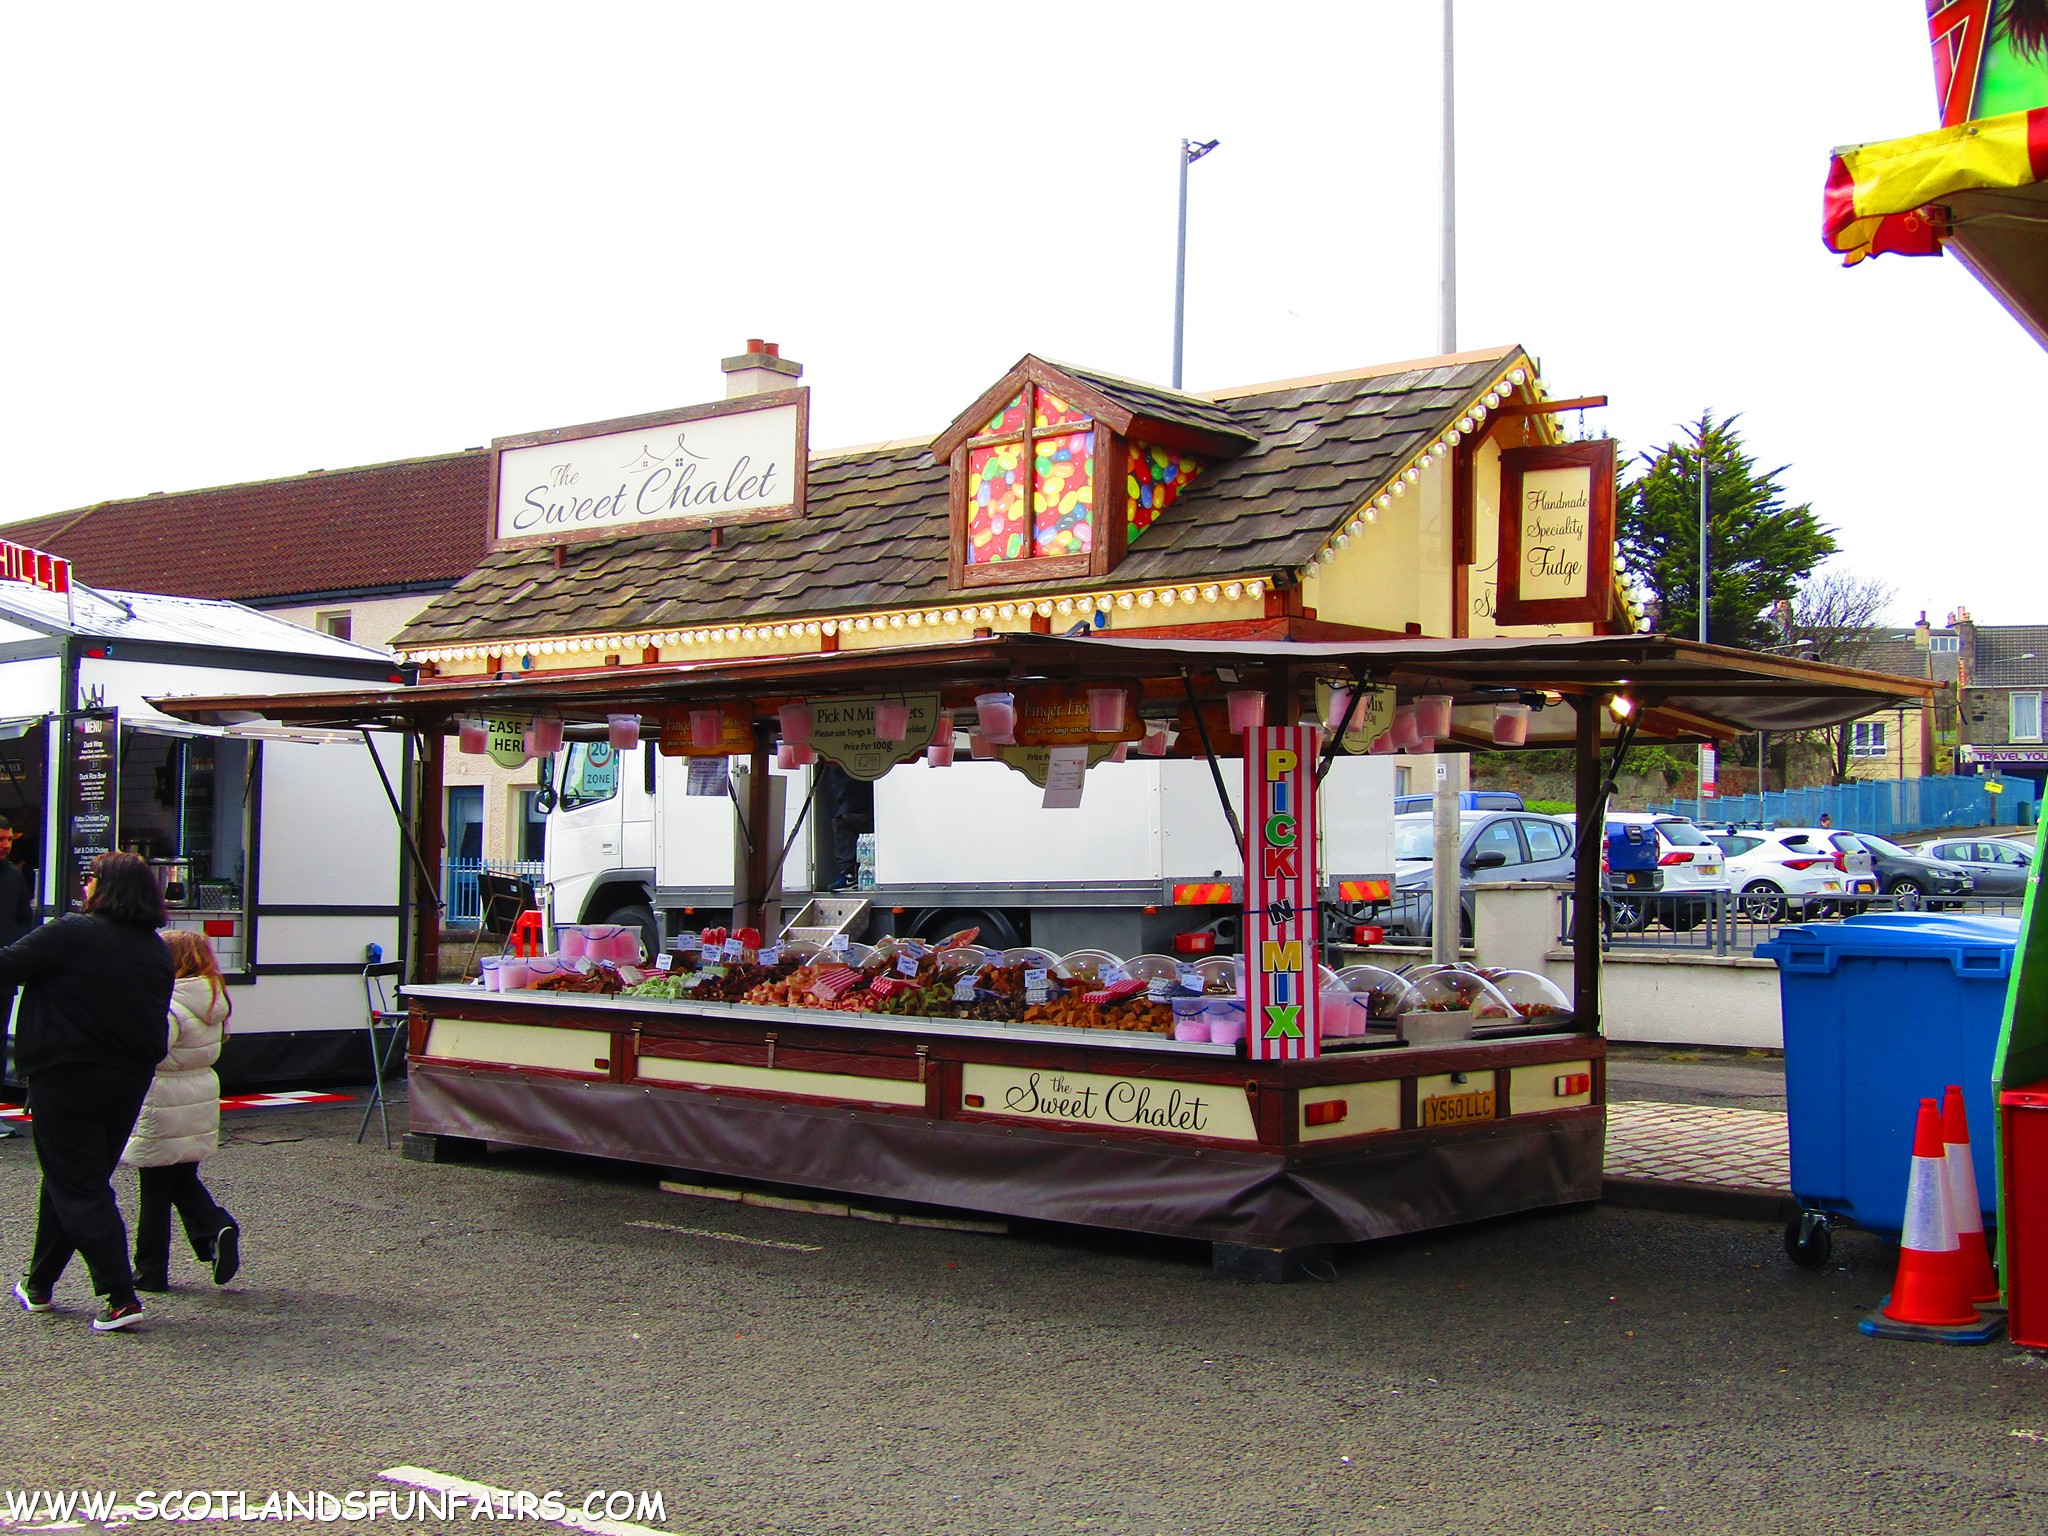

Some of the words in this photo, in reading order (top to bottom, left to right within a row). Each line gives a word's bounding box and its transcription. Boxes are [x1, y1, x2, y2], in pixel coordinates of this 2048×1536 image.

[549, 463, 580, 488] The
[513, 484, 627, 530] Sweet
[636, 455, 776, 515] Chalet
[1526, 489, 1589, 511] Handmade
[1526, 516, 1584, 543] Speciality
[1527, 546, 1582, 585] Fudge
[817, 703, 840, 723] Pick
[843, 706, 854, 722] N
[857, 703, 874, 721] Mi
[1024, 700, 1062, 723] Finger
[1364, 711, 1376, 725] 00g
[84, 721, 103, 733] MENU
[489, 719, 522, 734] EASE
[666, 717, 691, 736] Finge
[494, 738, 525, 752] HER
[591, 742, 608, 756] 20
[843, 742, 859, 751] Price
[860, 742, 872, 750] Per
[873, 740, 893, 753] 100g
[1977, 752, 2022, 760] TRAVEL
[586, 774, 610, 784] ZONE
[1437, 767, 1444, 775] 43
[1264, 749, 1299, 879] PICK
[1268, 897, 1295, 926] N
[1260, 940, 1304, 1039] MIX
[1050, 1075, 1073, 1095] the
[1003, 1072, 1099, 1119] Sweet
[1104, 1081, 1209, 1131] Chalet
[1431, 1098, 1464, 1122] YS60
[1466, 1095, 1491, 1117] LLC
